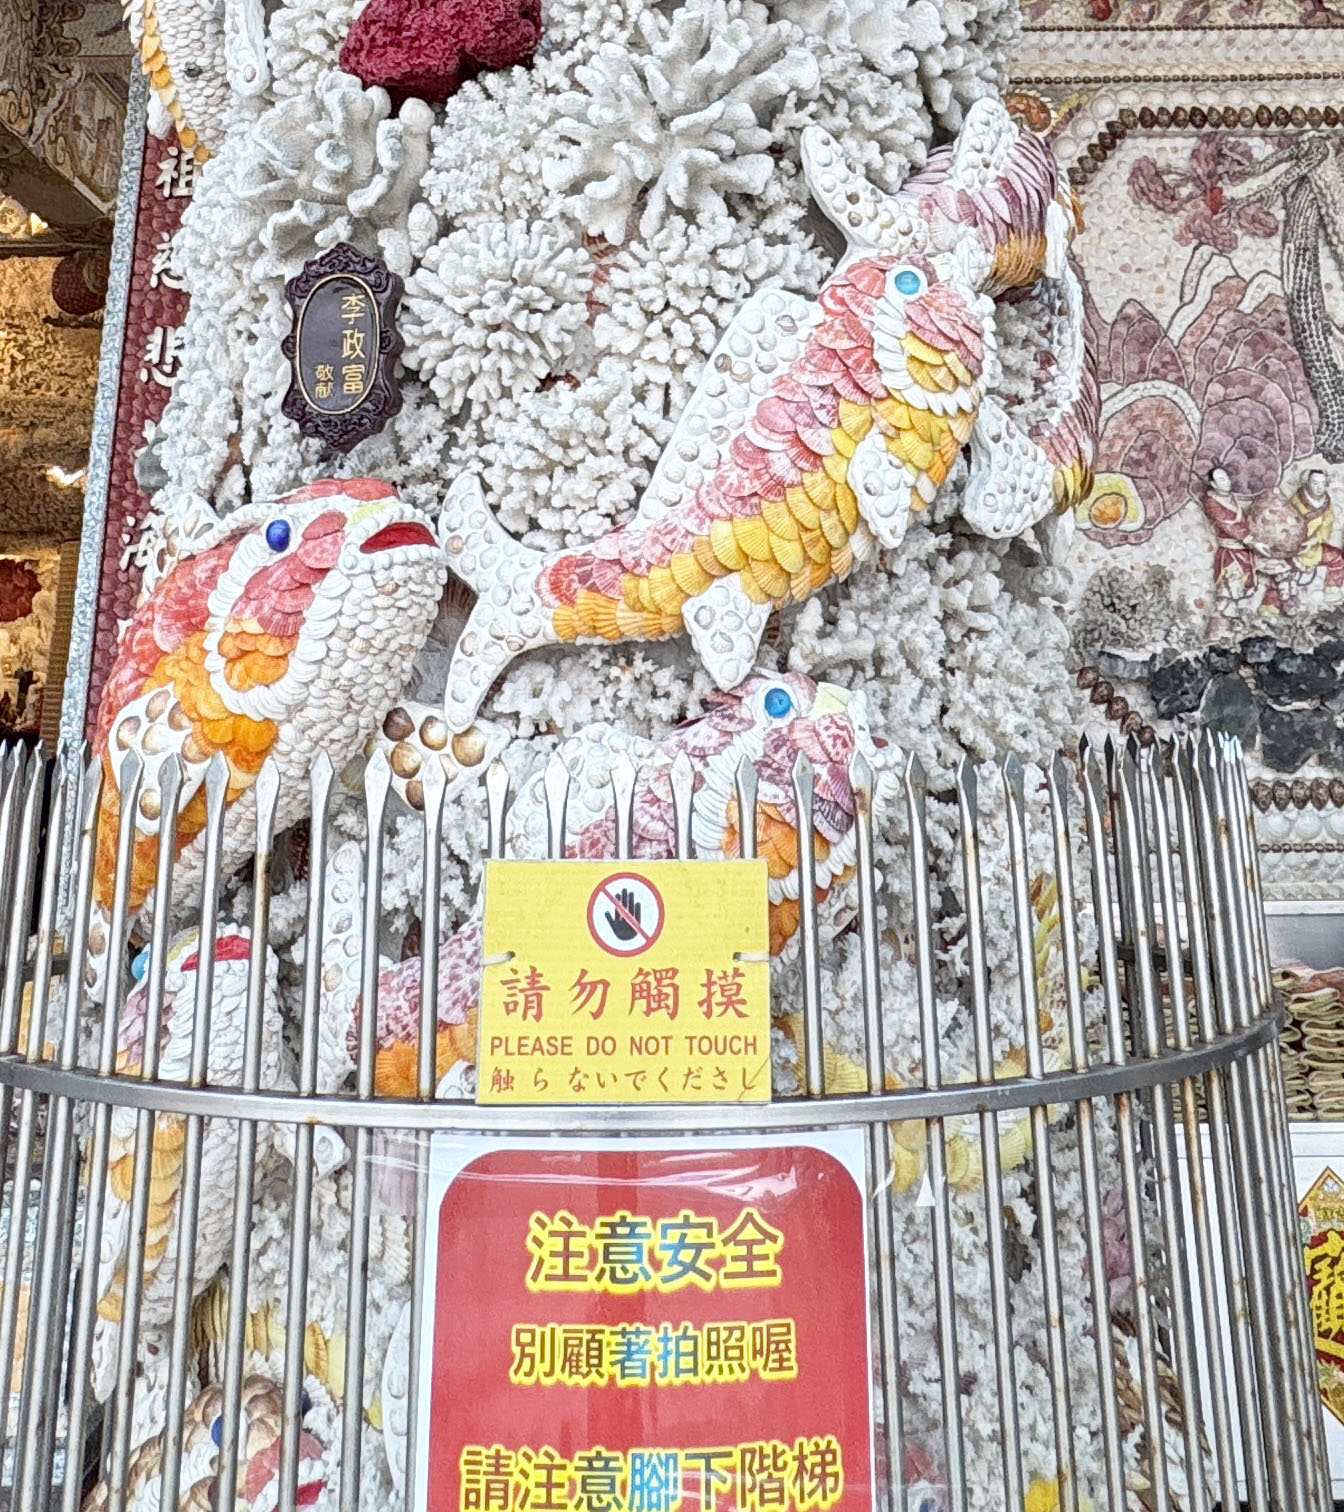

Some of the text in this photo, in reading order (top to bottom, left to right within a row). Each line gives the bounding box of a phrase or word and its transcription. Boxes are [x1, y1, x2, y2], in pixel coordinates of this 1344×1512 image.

[340, 293, 366, 395] 李政富
[499, 965, 751, 1023] 請勿觸摸
[490, 1035, 758, 1056] PLEASE DO NOT TOUCH
[528, 1210, 783, 1287] 注意安全
[512, 1320, 796, 1381] 別顧著拍照喔
[462, 1439, 841, 1512] 請注意腳下階梯
